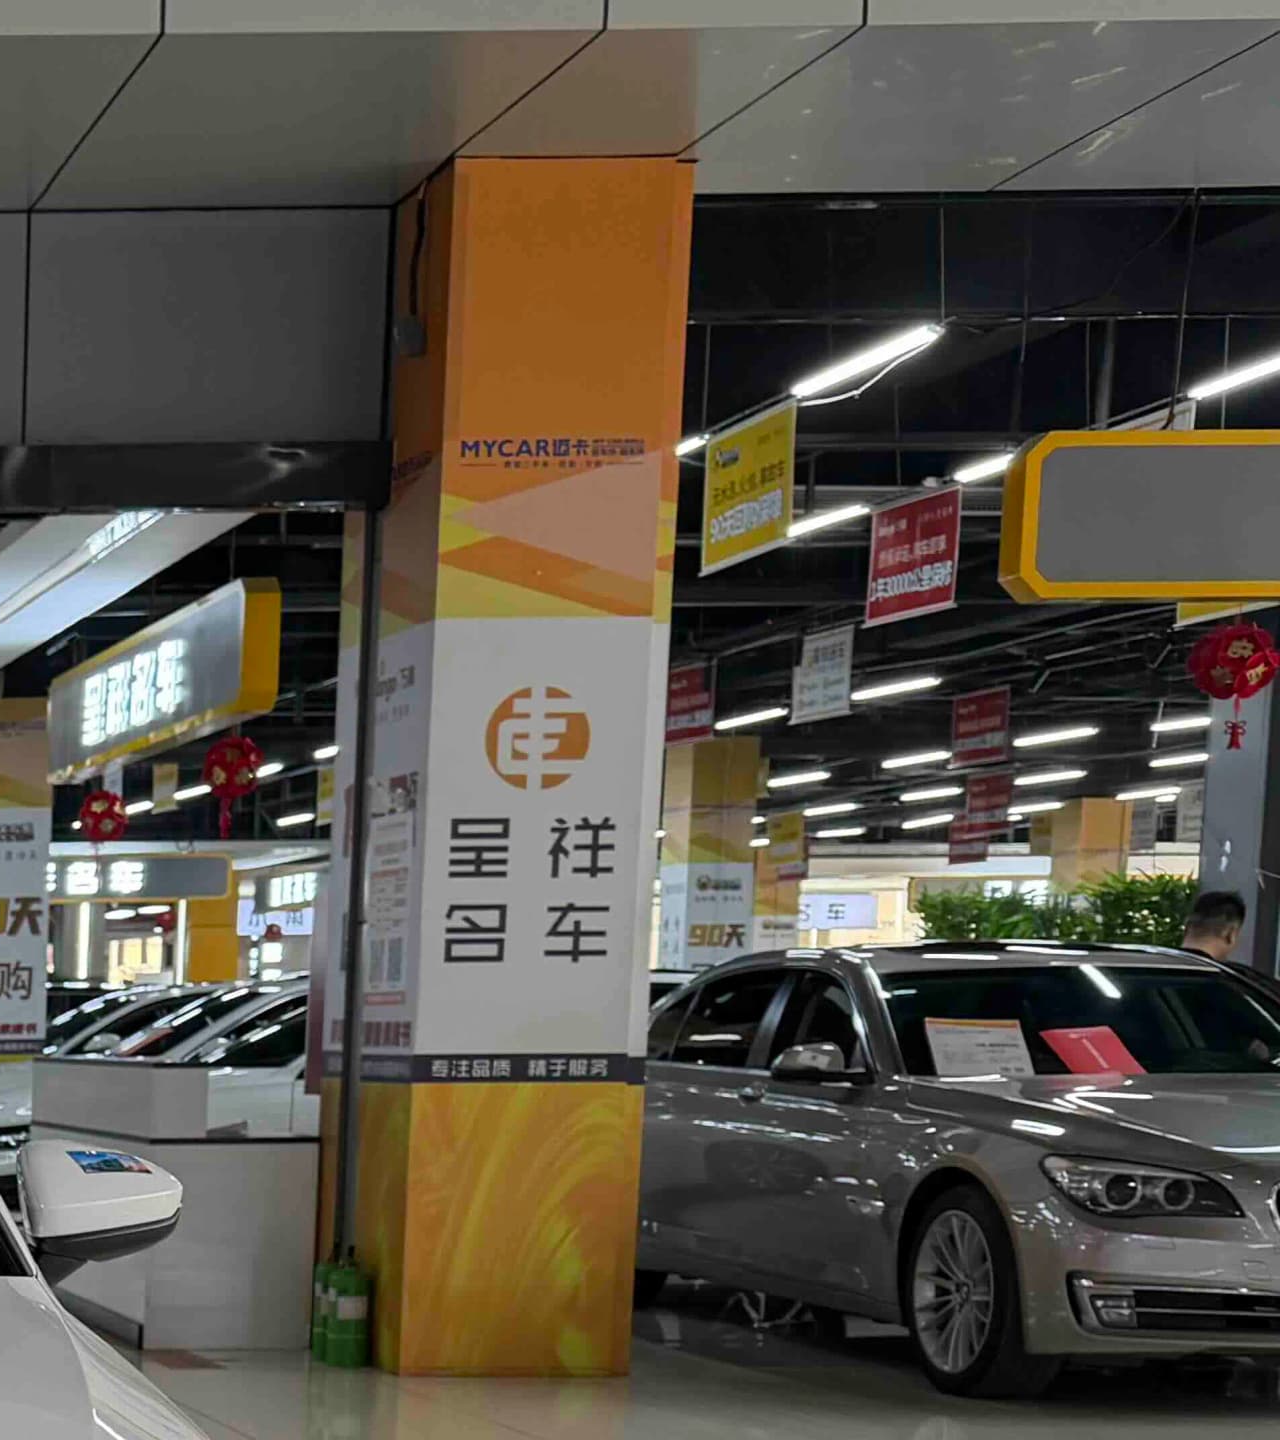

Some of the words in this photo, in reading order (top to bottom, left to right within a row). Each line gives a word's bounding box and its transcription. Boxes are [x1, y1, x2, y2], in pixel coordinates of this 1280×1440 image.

[448, 816, 617, 880] 呈祥
[443, 901, 611, 964] 名车
[431, 1058, 512, 1079] 专注品质
[528, 1058, 609, 1079] 精于服务
